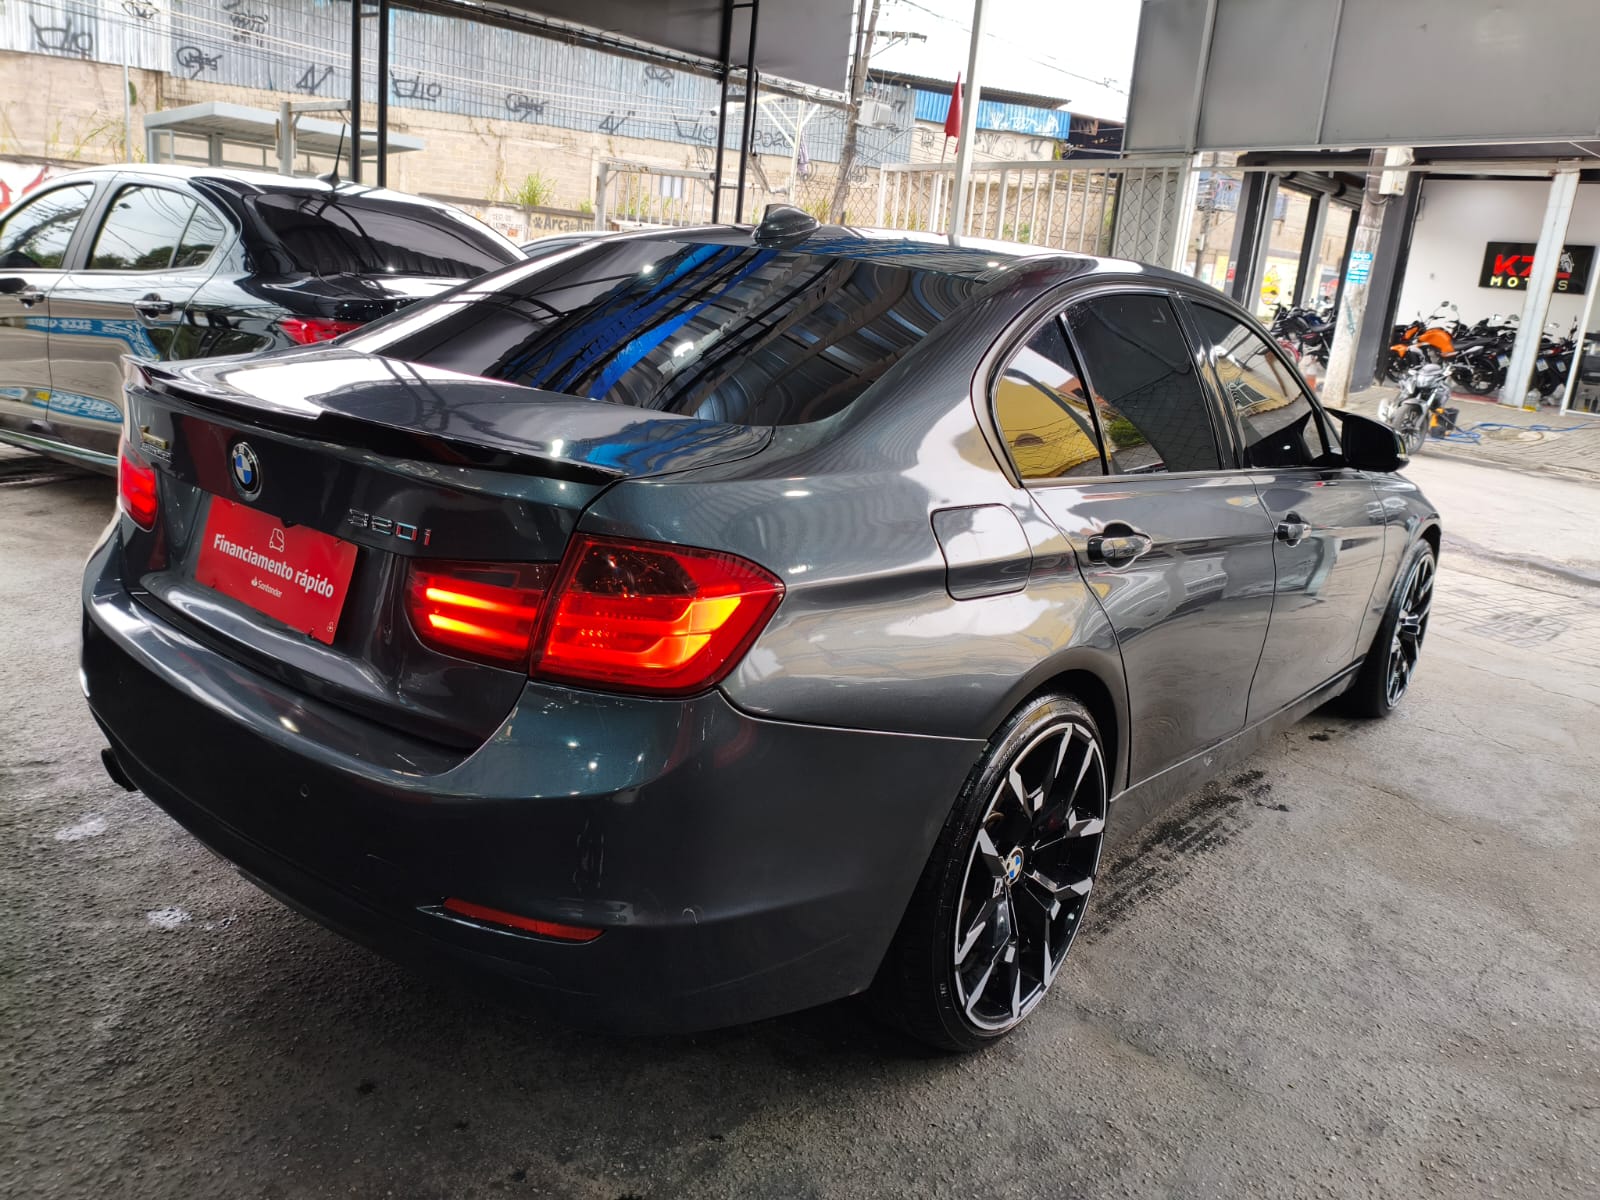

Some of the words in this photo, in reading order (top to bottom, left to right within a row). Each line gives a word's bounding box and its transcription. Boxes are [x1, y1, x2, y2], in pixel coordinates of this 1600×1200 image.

[543, 215, 570, 231] Arca
[213, 533, 293, 580] Financiamento
[294, 569, 334, 598] rápido
